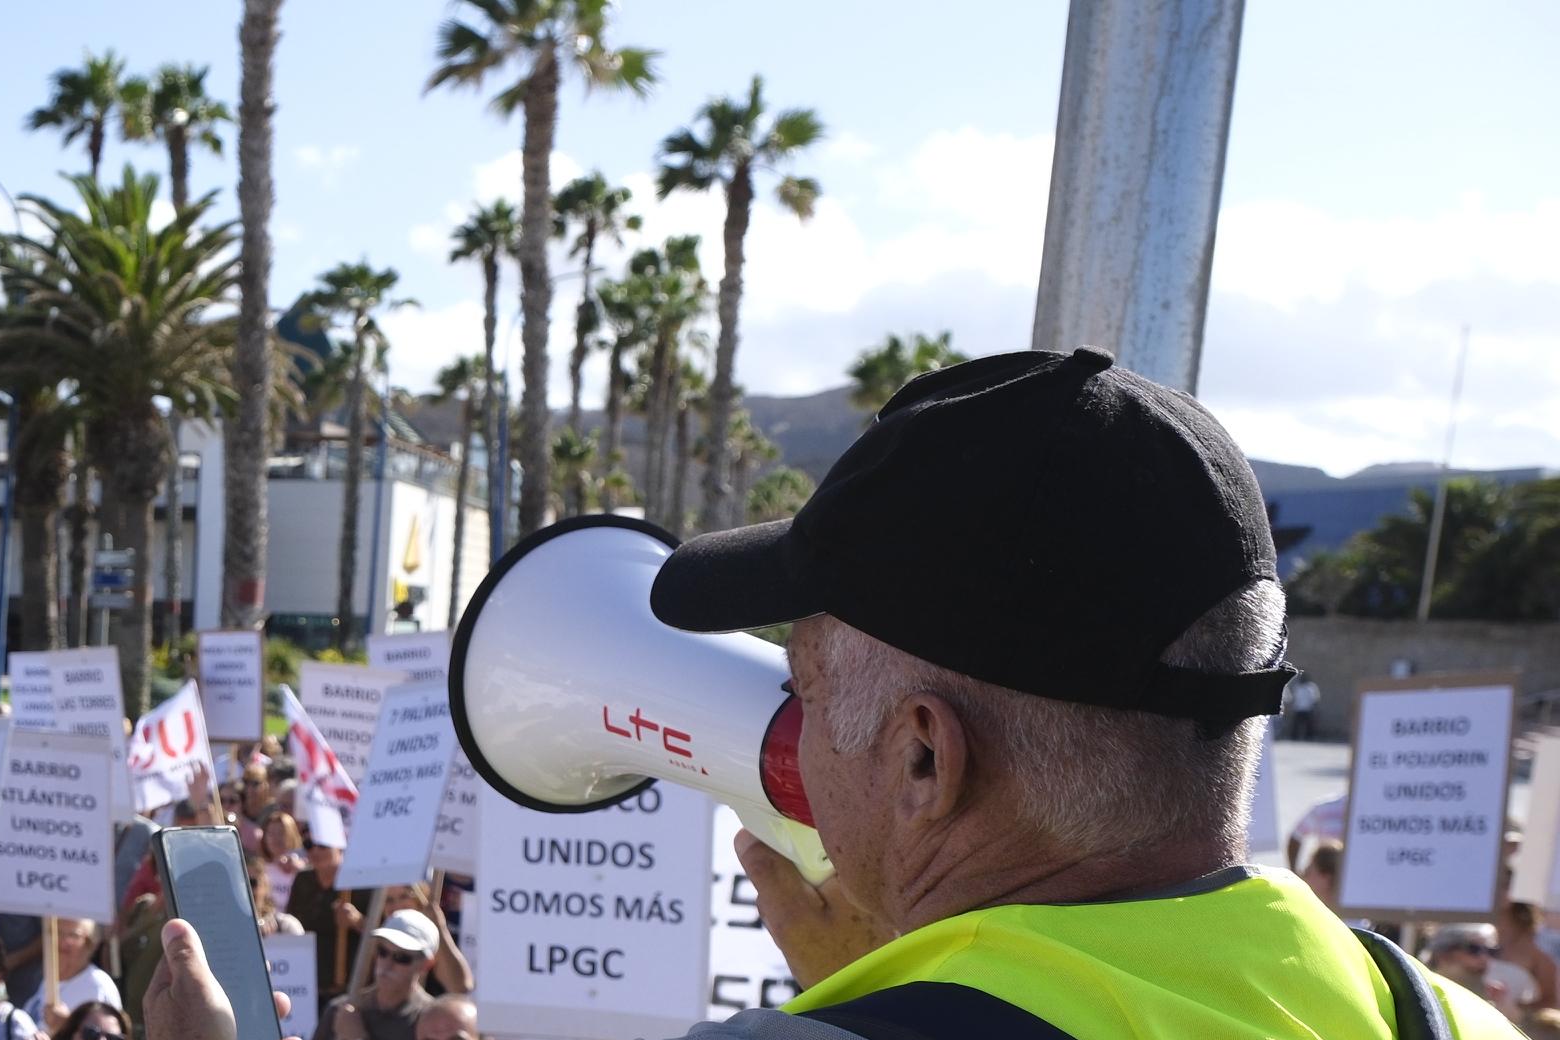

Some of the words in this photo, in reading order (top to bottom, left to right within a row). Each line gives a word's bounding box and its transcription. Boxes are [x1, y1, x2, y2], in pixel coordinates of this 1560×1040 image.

[319, 726, 373, 744] UNIDO
[1392, 715, 1472, 738] BARRIO
[10, 759, 82, 780] BARRIO
[1383, 781, 1468, 802] UNIDOS
[11, 816, 84, 838] UNIDOS
[1358, 815, 1435, 836] SOMOS
[521, 836, 656, 869] UNIDOS
[1386, 847, 1437, 868] LPGC
[16, 871, 70, 893] LPGC
[490, 887, 605, 919] SOMOS
[614, 891, 685, 925] MÁS
[528, 943, 626, 980] LPGC
